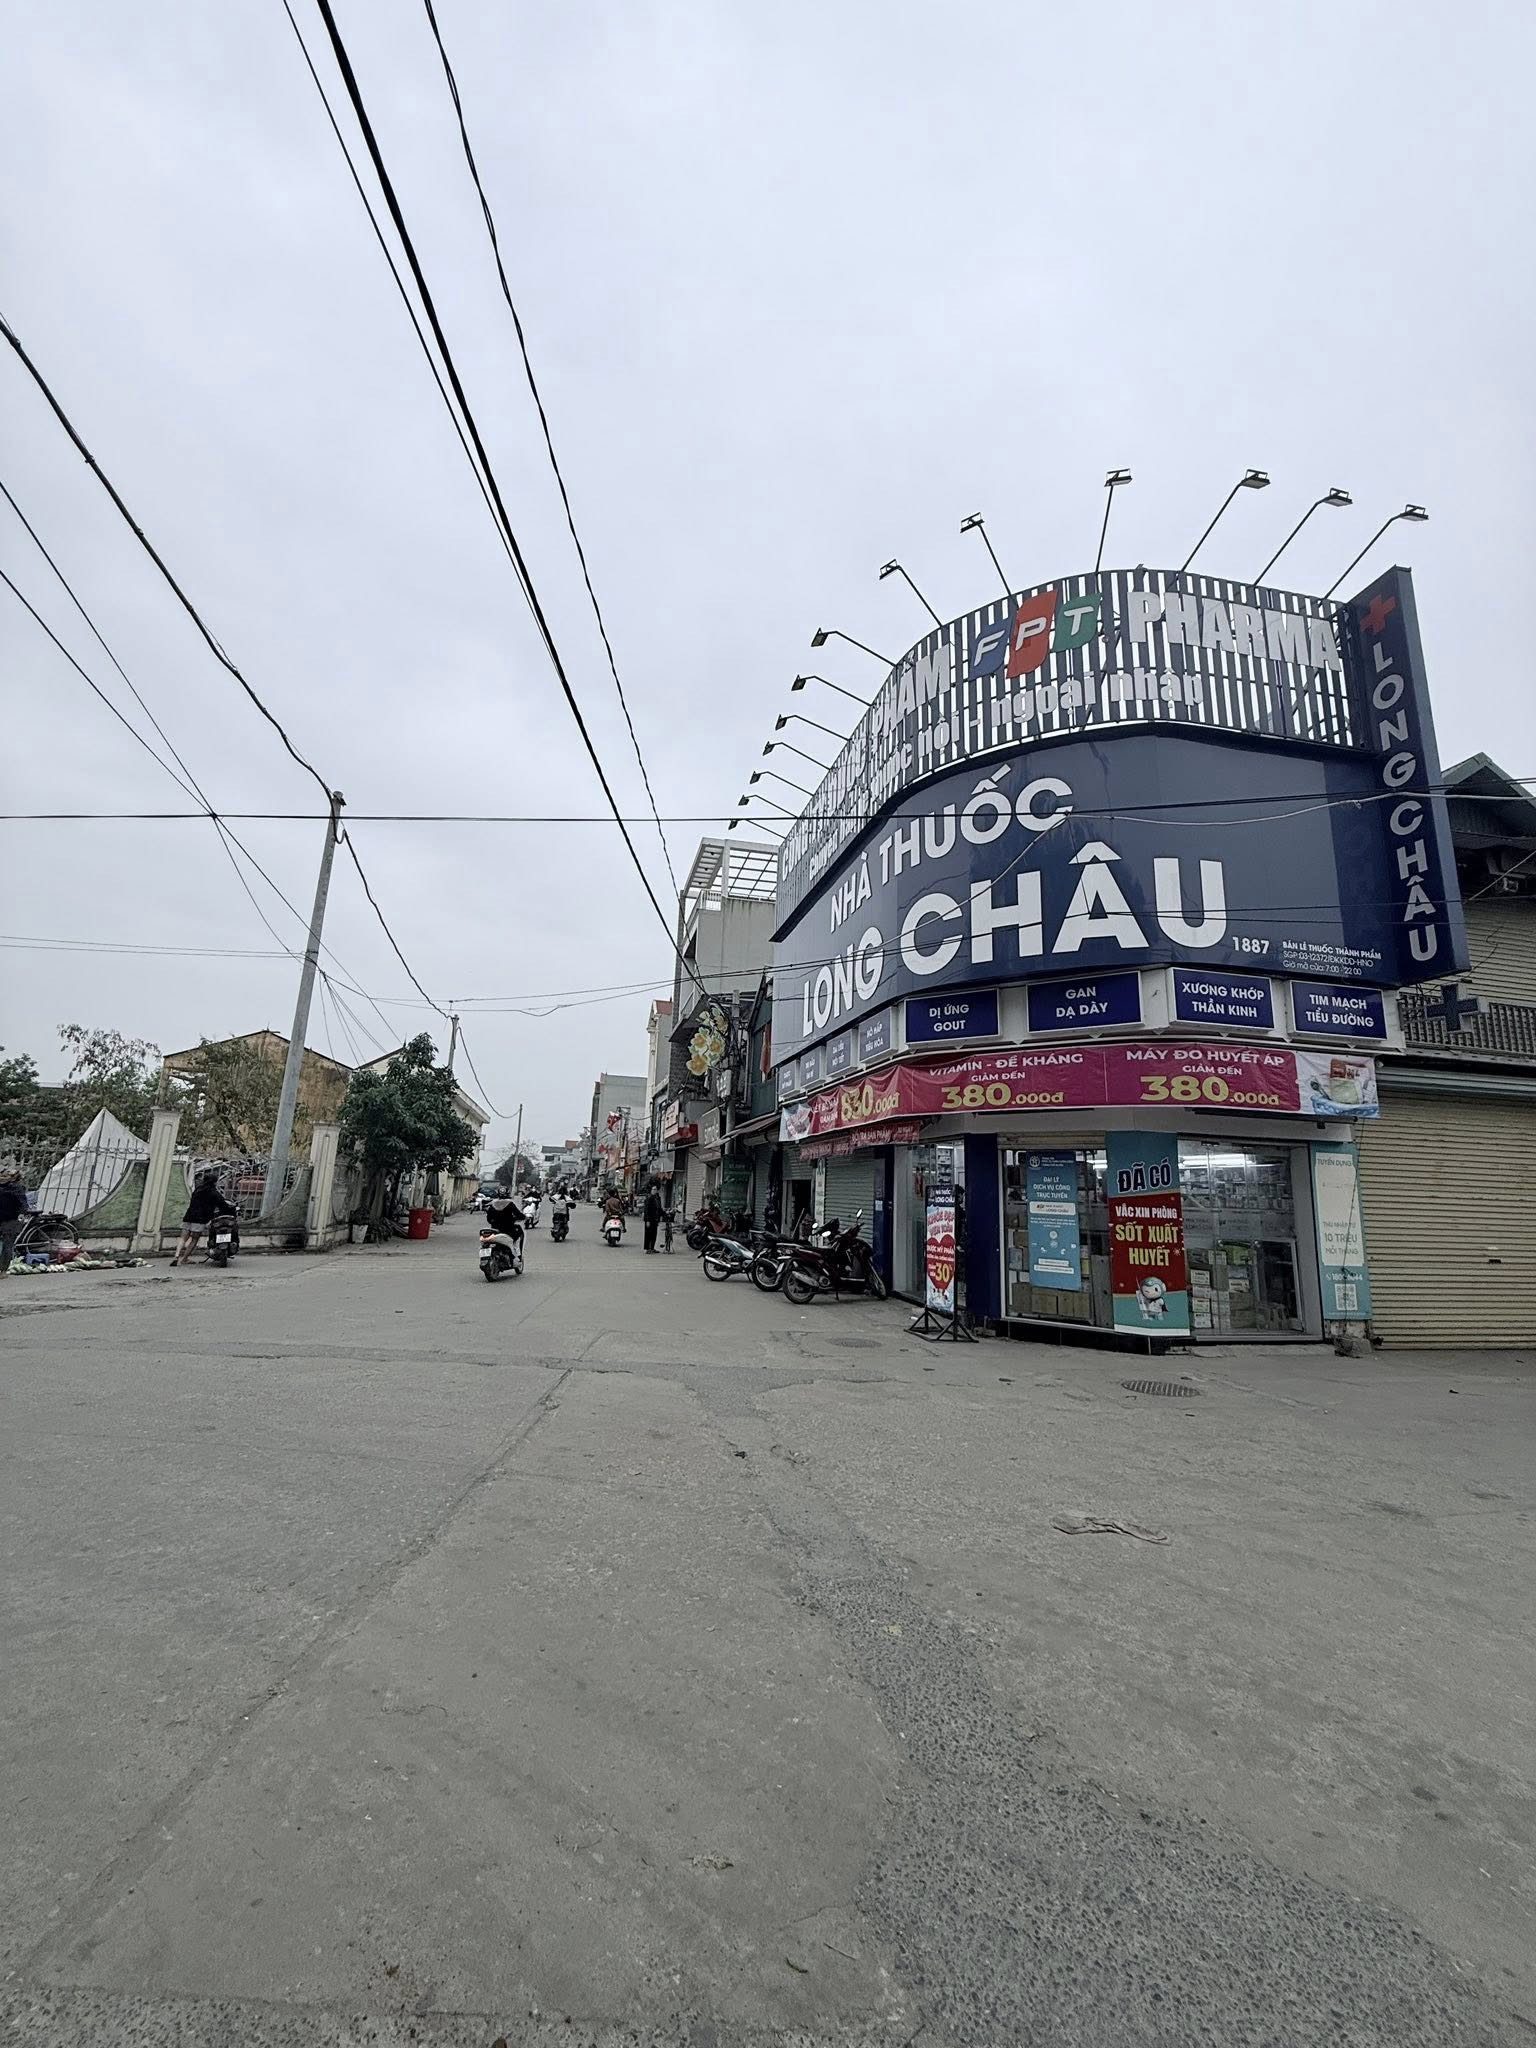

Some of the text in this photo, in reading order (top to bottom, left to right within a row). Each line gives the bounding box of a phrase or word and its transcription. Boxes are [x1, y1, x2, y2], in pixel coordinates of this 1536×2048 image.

[871, 644, 950, 753] PHẨM
[974, 605, 1095, 667] FPT
[1127, 591, 1342, 672] PHARMA
[917, 710, 959, 759] nội
[991, 670, 1097, 727] ngoại
[1109, 666, 1204, 708] nhập
[1372, 641, 1416, 788] LONG
[830, 764, 1075, 934] NHÀ THUỐC
[1389, 800, 1438, 962] CHÂU
[802, 841, 1270, 1038] LONG CHÂU 1887
[1308, 942, 1334, 954] THUỐC
[1335, 945, 1360, 958] THÀNH
[1360, 949, 1382, 960] PHẨM
[1065, 986, 1097, 1000] GAN
[1181, 981, 1265, 1001] XƯƠNG KHỚP
[929, 1003, 970, 1019] DỊ ỨNG
[1056, 1001, 1109, 1020] DẠ DÀY
[1191, 999, 1258, 1018] THẦN KINH
[1308, 994, 1368, 1012] TIM MẠCH
[933, 1020, 967, 1032] GOUT
[1305, 1009, 1375, 1028] TIỂU ĐƯỜNG
[930, 1060, 983, 1077] VITAMIN
[995, 1055, 1018, 1068] ĐỀ
[1022, 1053, 1084, 1067] KHÁNG
[1126, 1048, 1285, 1066] MÁY ĐO HUYẾT ÁP
[971, 1070, 1026, 1082] GIẢM ĐẾN
[1181, 1064, 1243, 1076] GIẢM ĐẾN
[1117, 1157, 1173, 1193] ĐÃ CÓ
[1135, 1206, 1150, 1218] XIN
[1151, 1205, 1178, 1219] PHÒNG
[1115, 1221, 1144, 1242] SỐT
[1148, 1222, 1179, 1243] XUẤT
[1324, 1232, 1358, 1246] 10 TRỆU
[1128, 1245, 1171, 1266] HUYẾT
